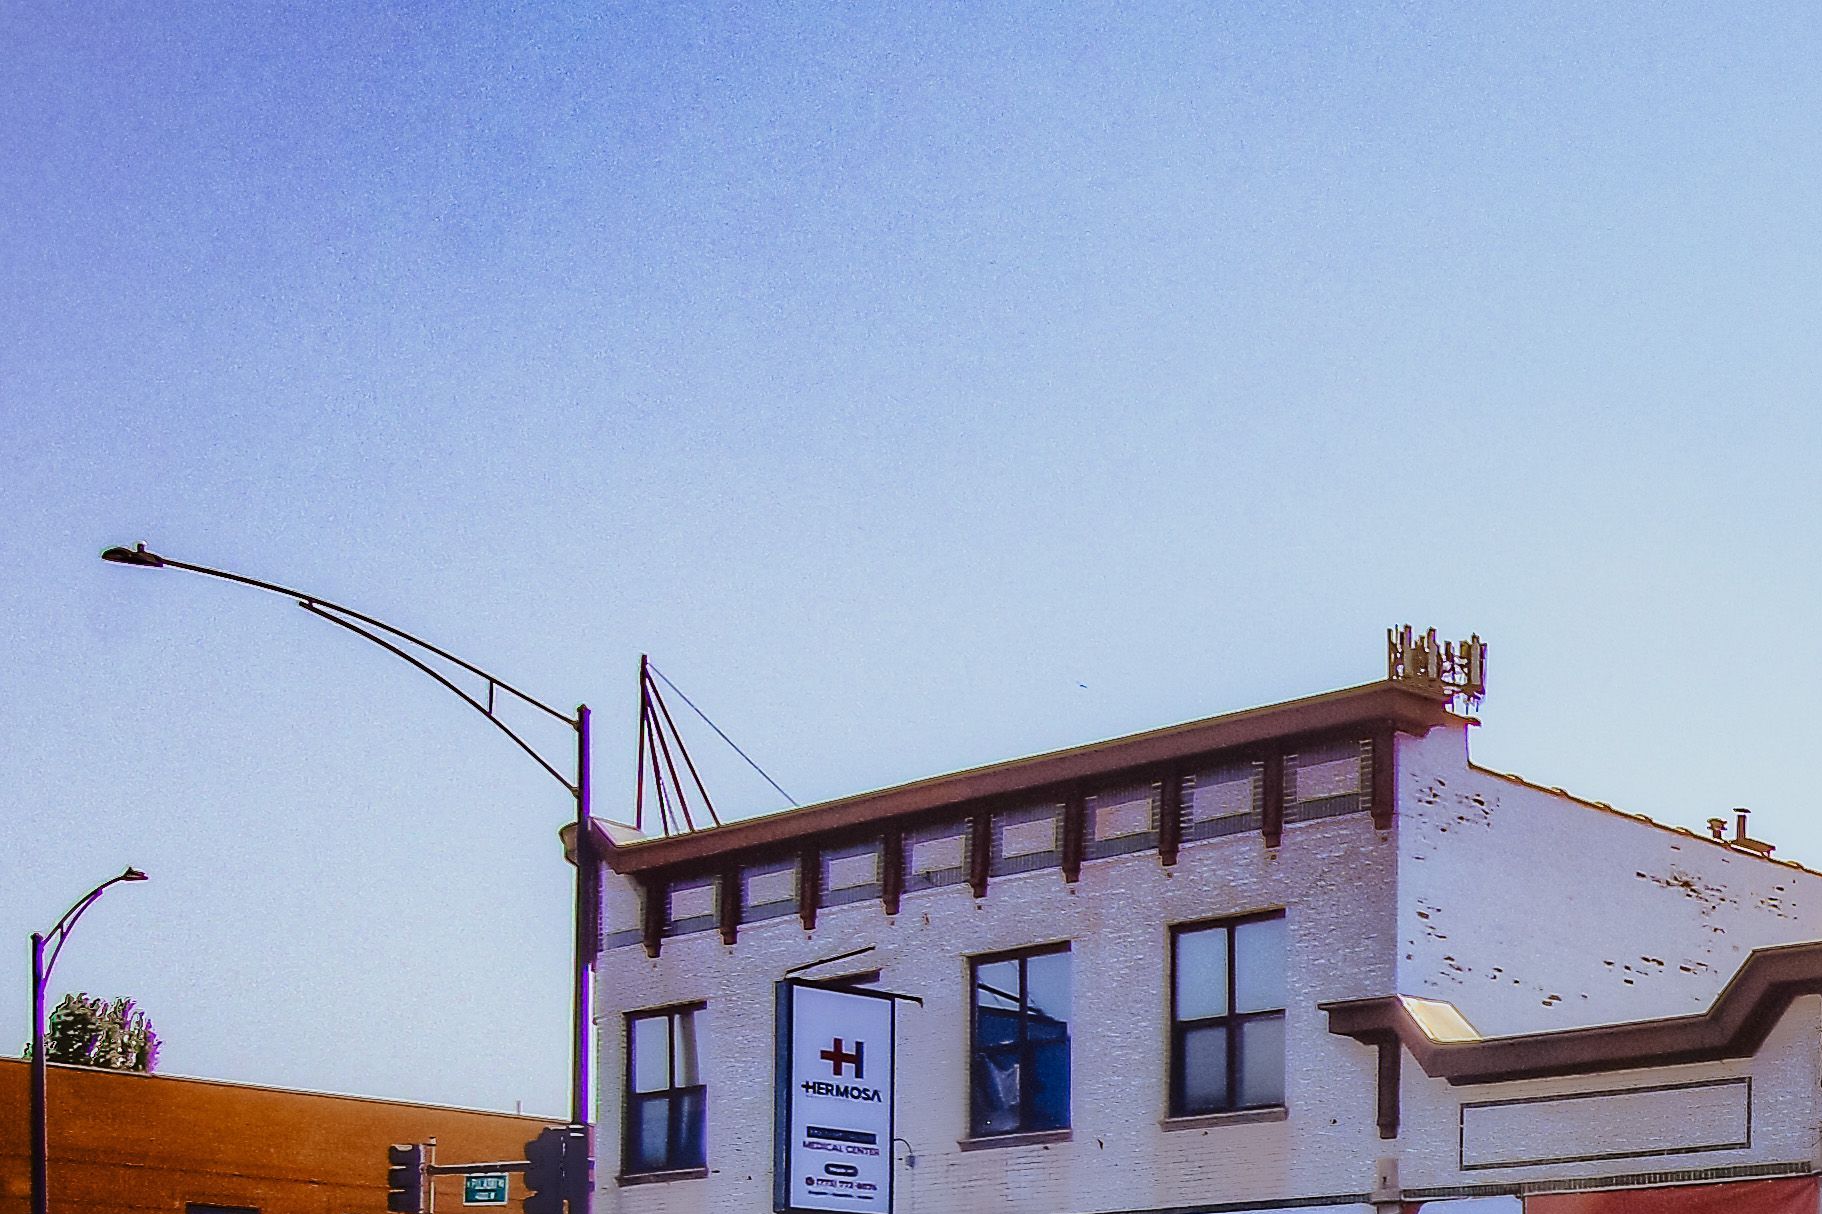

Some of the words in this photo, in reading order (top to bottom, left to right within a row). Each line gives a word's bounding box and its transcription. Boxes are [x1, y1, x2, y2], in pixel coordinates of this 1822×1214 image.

[801, 1080, 881, 1102] HERMOSA
[803, 1141, 843, 1152] MEDICAL
[846, 1146, 880, 1156] CENTER
